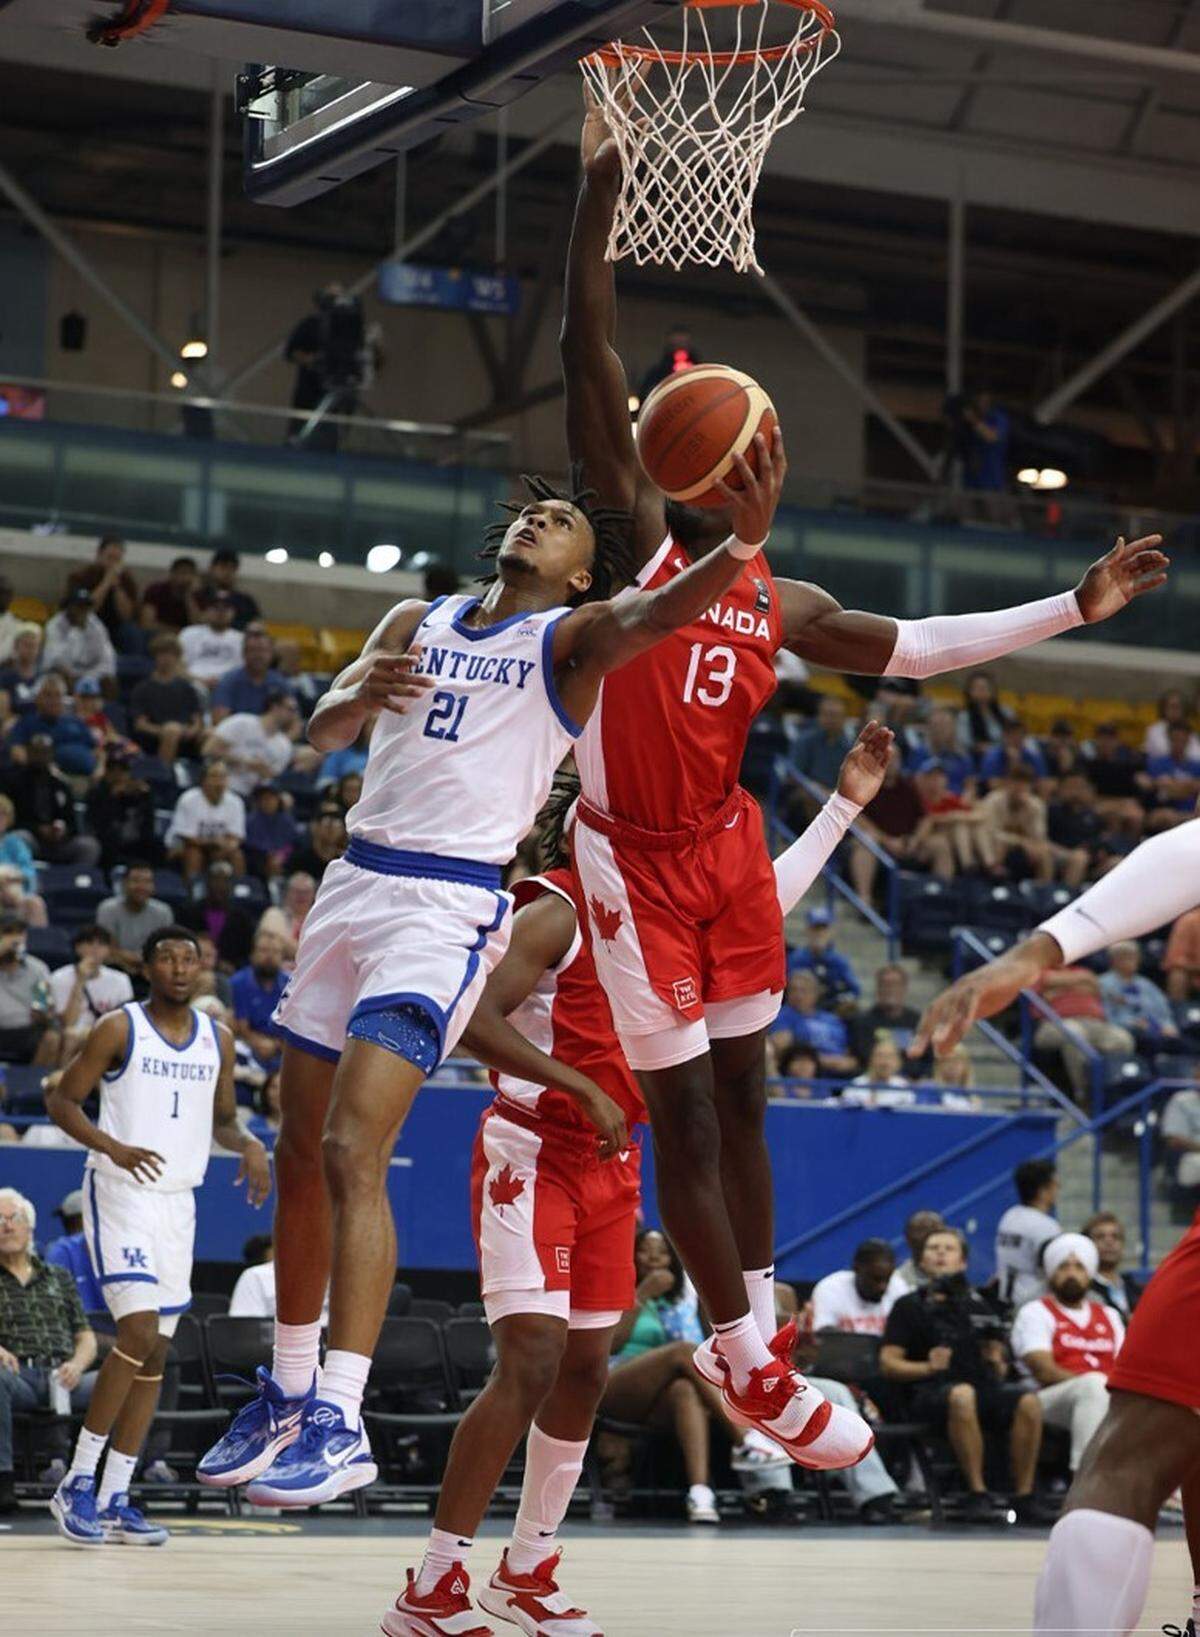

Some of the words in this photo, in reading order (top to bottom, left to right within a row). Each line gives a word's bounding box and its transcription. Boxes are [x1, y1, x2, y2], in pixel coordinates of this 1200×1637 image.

[700, 602, 771, 641] NADA
[409, 646, 536, 690] ENTUCKY
[683, 642, 737, 707] 13
[423, 691, 469, 742] 21
[142, 1057, 215, 1081] KENTUCKY
[170, 1091, 179, 1119] 1
